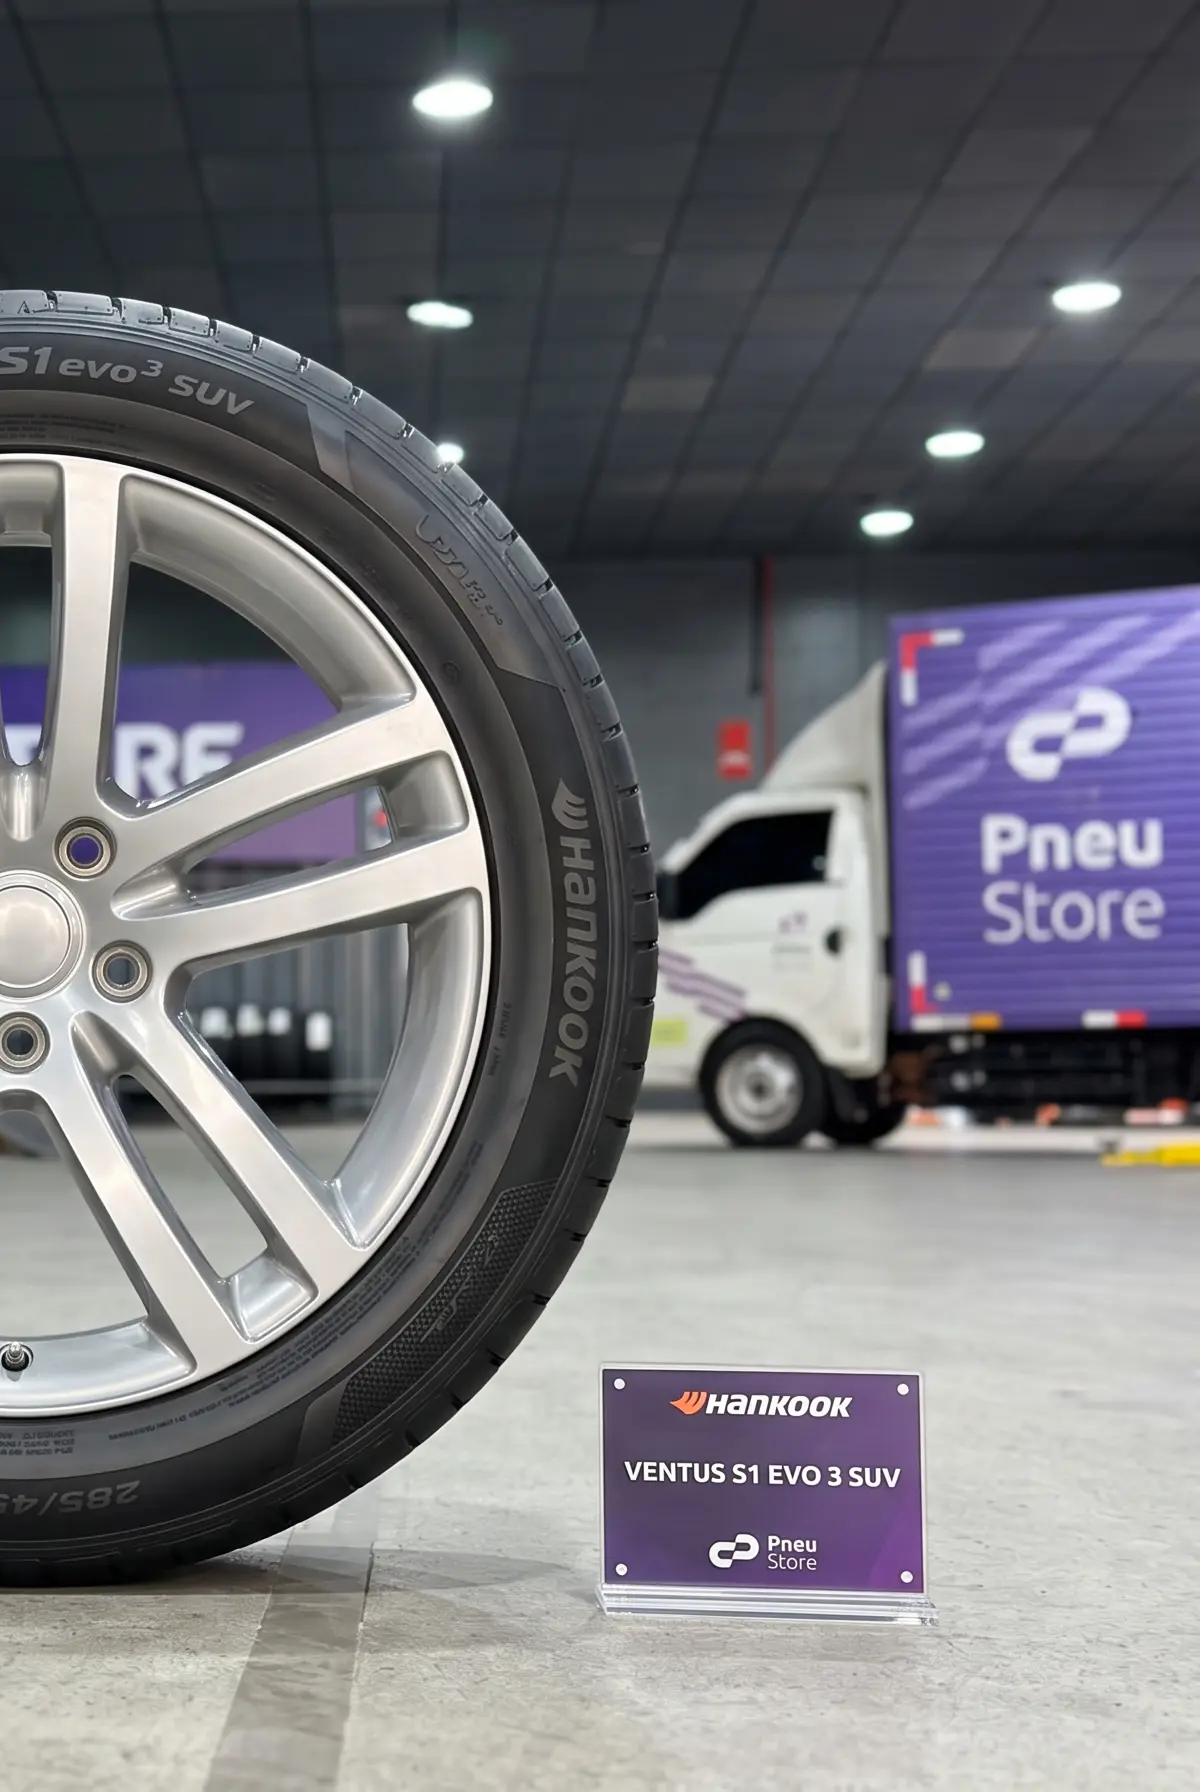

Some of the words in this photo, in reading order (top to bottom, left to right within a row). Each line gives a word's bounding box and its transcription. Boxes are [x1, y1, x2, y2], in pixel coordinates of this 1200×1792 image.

[167, 374, 255, 416] SUV
[980, 813, 1163, 874] Pneu
[982, 880, 1165, 945] Store
[624, 1461, 725, 1484] VENTUS
[732, 1463, 759, 1484] S1
[768, 1465, 822, 1486] EVO
[828, 1466, 842, 1486] 3
[848, 1467, 901, 1487] SUV
[767, 1535, 817, 1553] Pneu
[767, 1553, 817, 1570] Store
